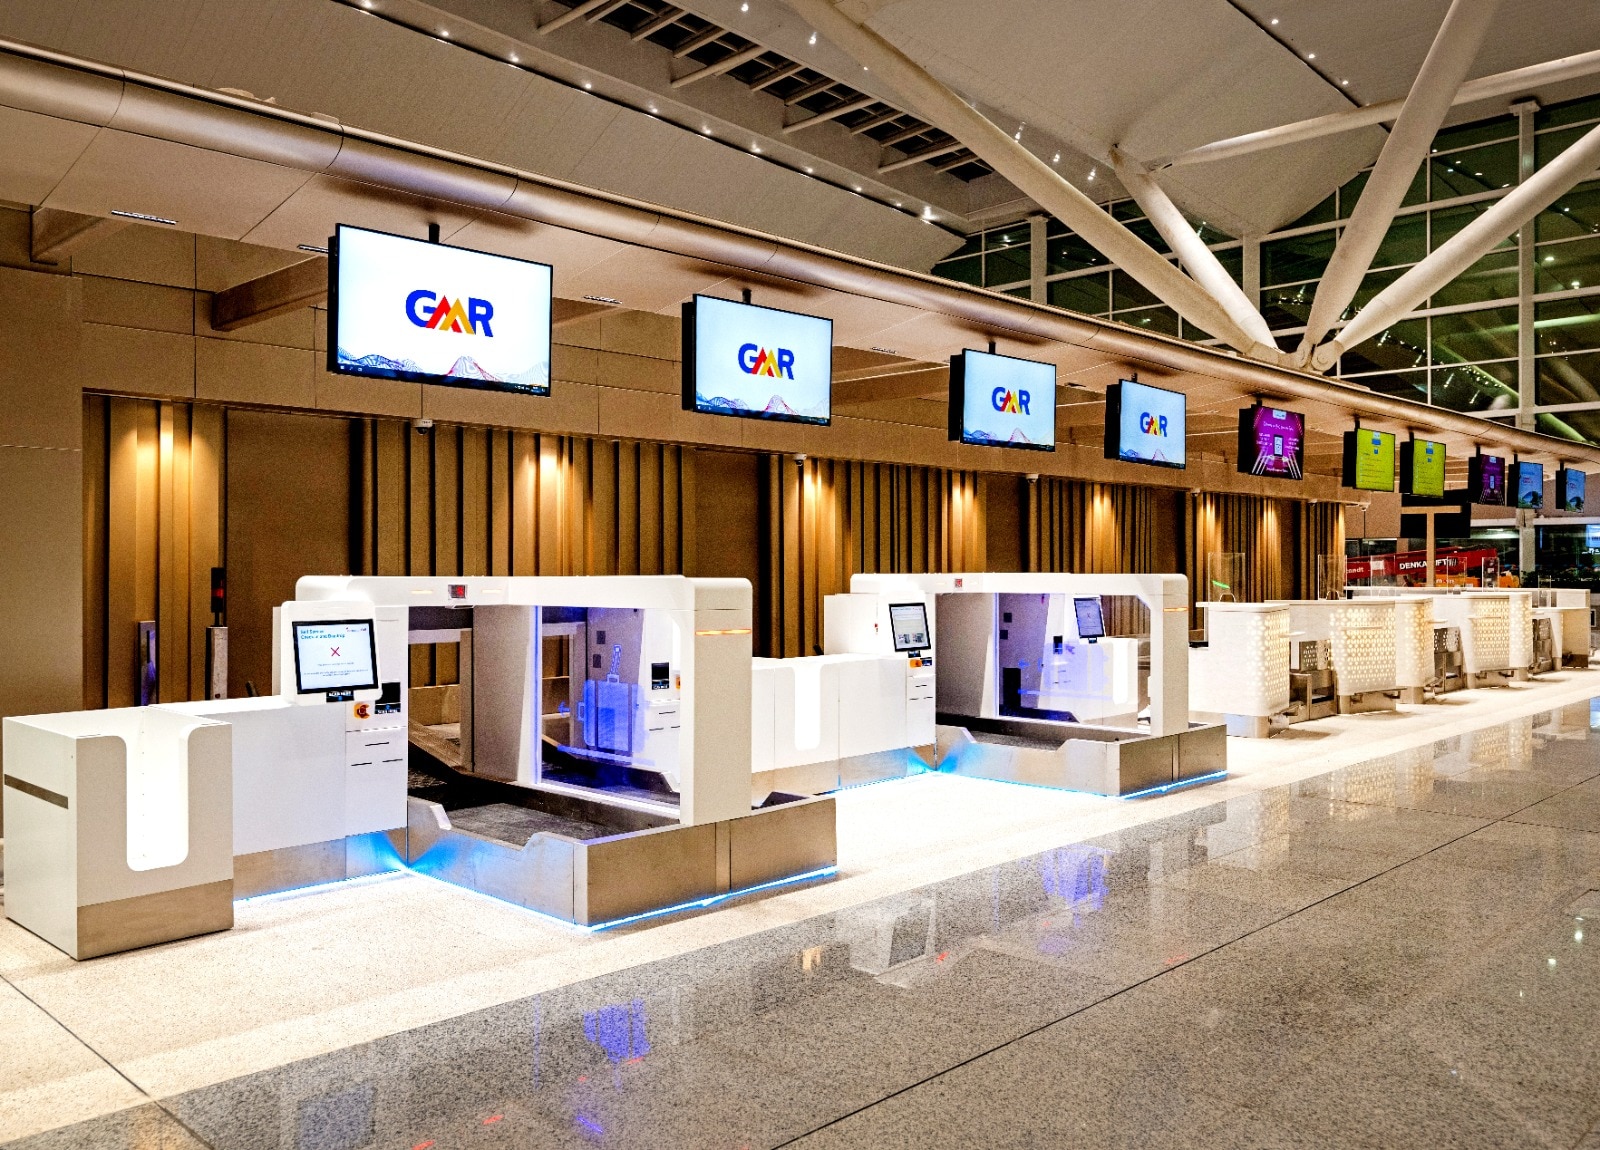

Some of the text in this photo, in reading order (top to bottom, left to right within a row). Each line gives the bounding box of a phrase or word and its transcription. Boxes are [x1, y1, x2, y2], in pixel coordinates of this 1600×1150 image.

[405, 289, 494, 338] GMR
[738, 343, 795, 380] GMR
[991, 386, 1031, 415] GMR
[1140, 411, 1168, 437] GMR
